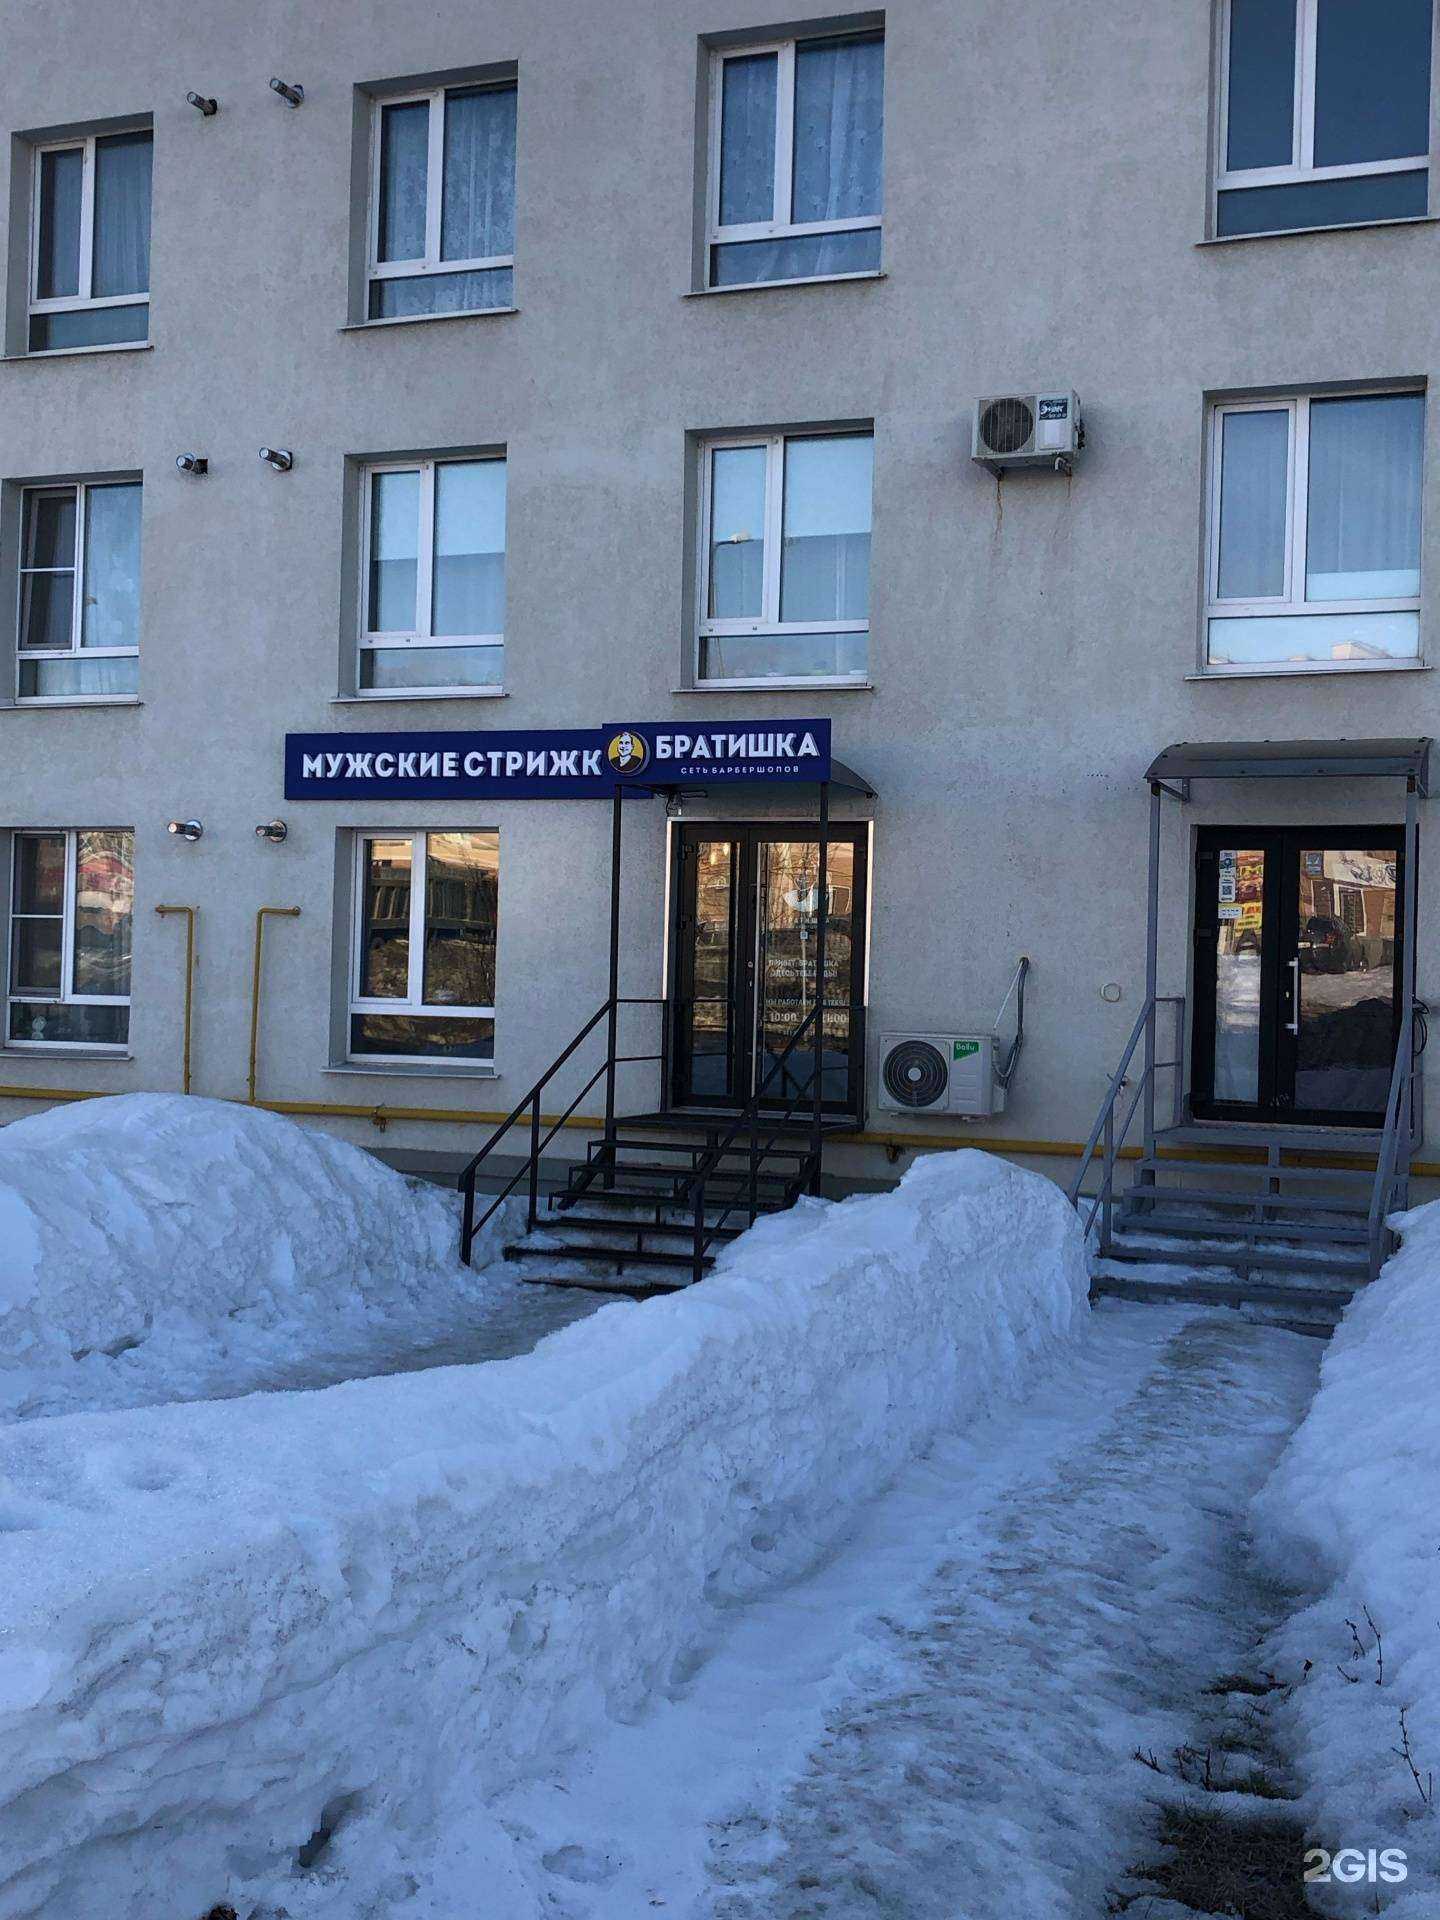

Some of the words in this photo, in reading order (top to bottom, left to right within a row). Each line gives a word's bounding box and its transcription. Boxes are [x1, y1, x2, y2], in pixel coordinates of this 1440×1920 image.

[656, 732, 820, 759] БРАТИШКА
[302, 752, 459, 778] МУЖСКИЕ
[463, 749, 603, 777] СТРИЖК
